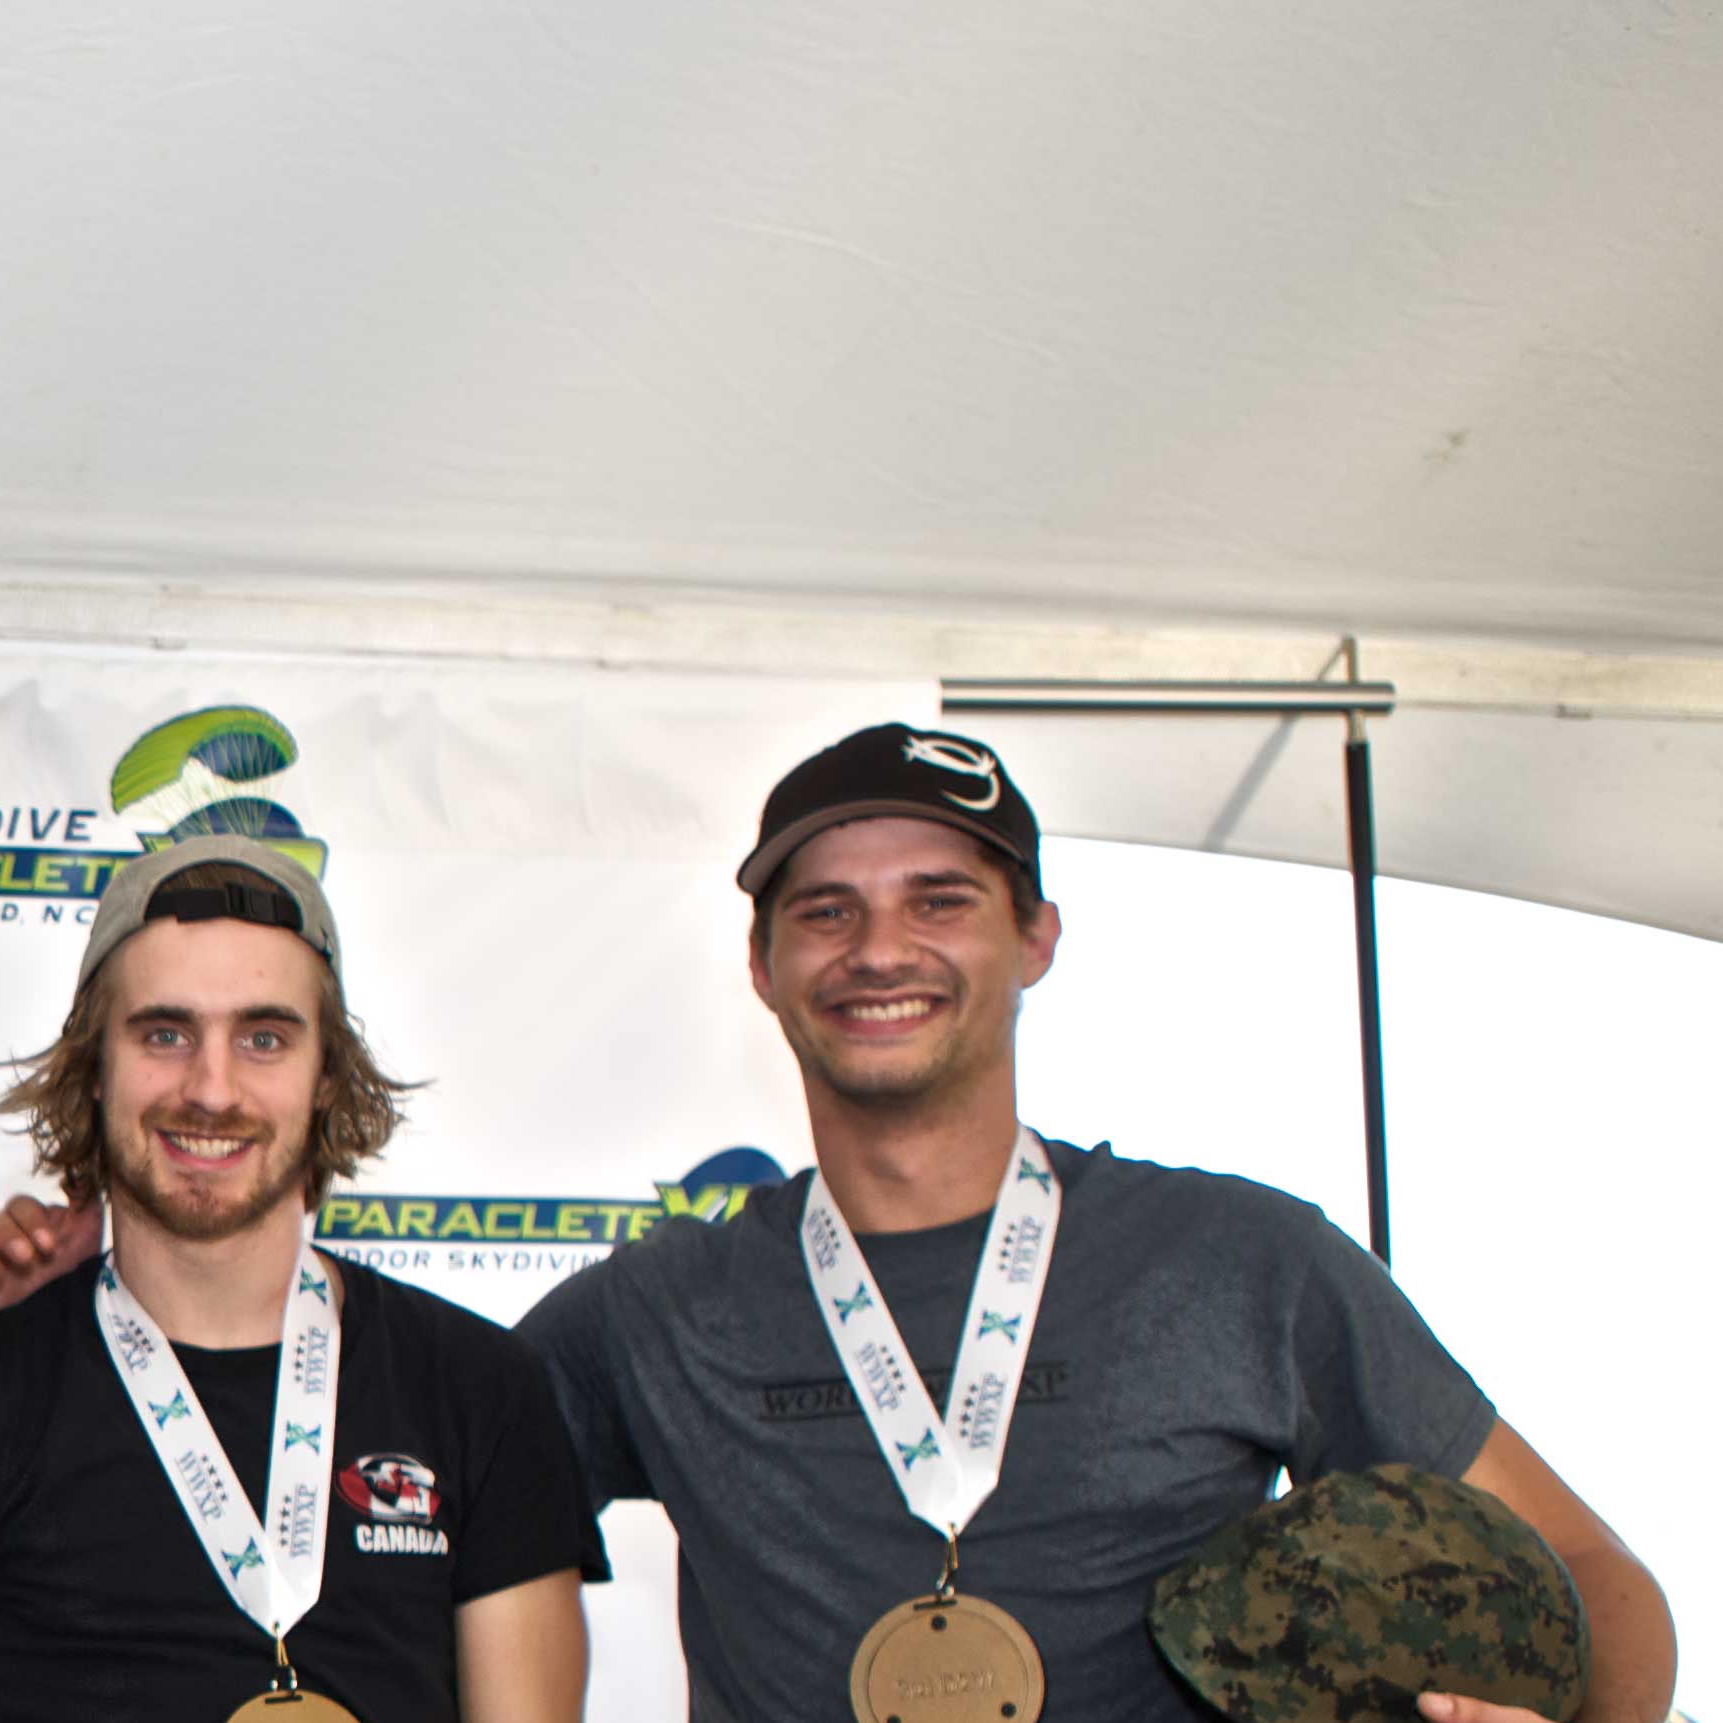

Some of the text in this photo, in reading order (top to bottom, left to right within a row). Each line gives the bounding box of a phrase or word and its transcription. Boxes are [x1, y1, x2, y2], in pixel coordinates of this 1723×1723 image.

[319, 1198, 663, 1240] PARACLETE
[447, 1250, 600, 1272] SKYDIVIN
[356, 1524, 449, 1556] CANADA
